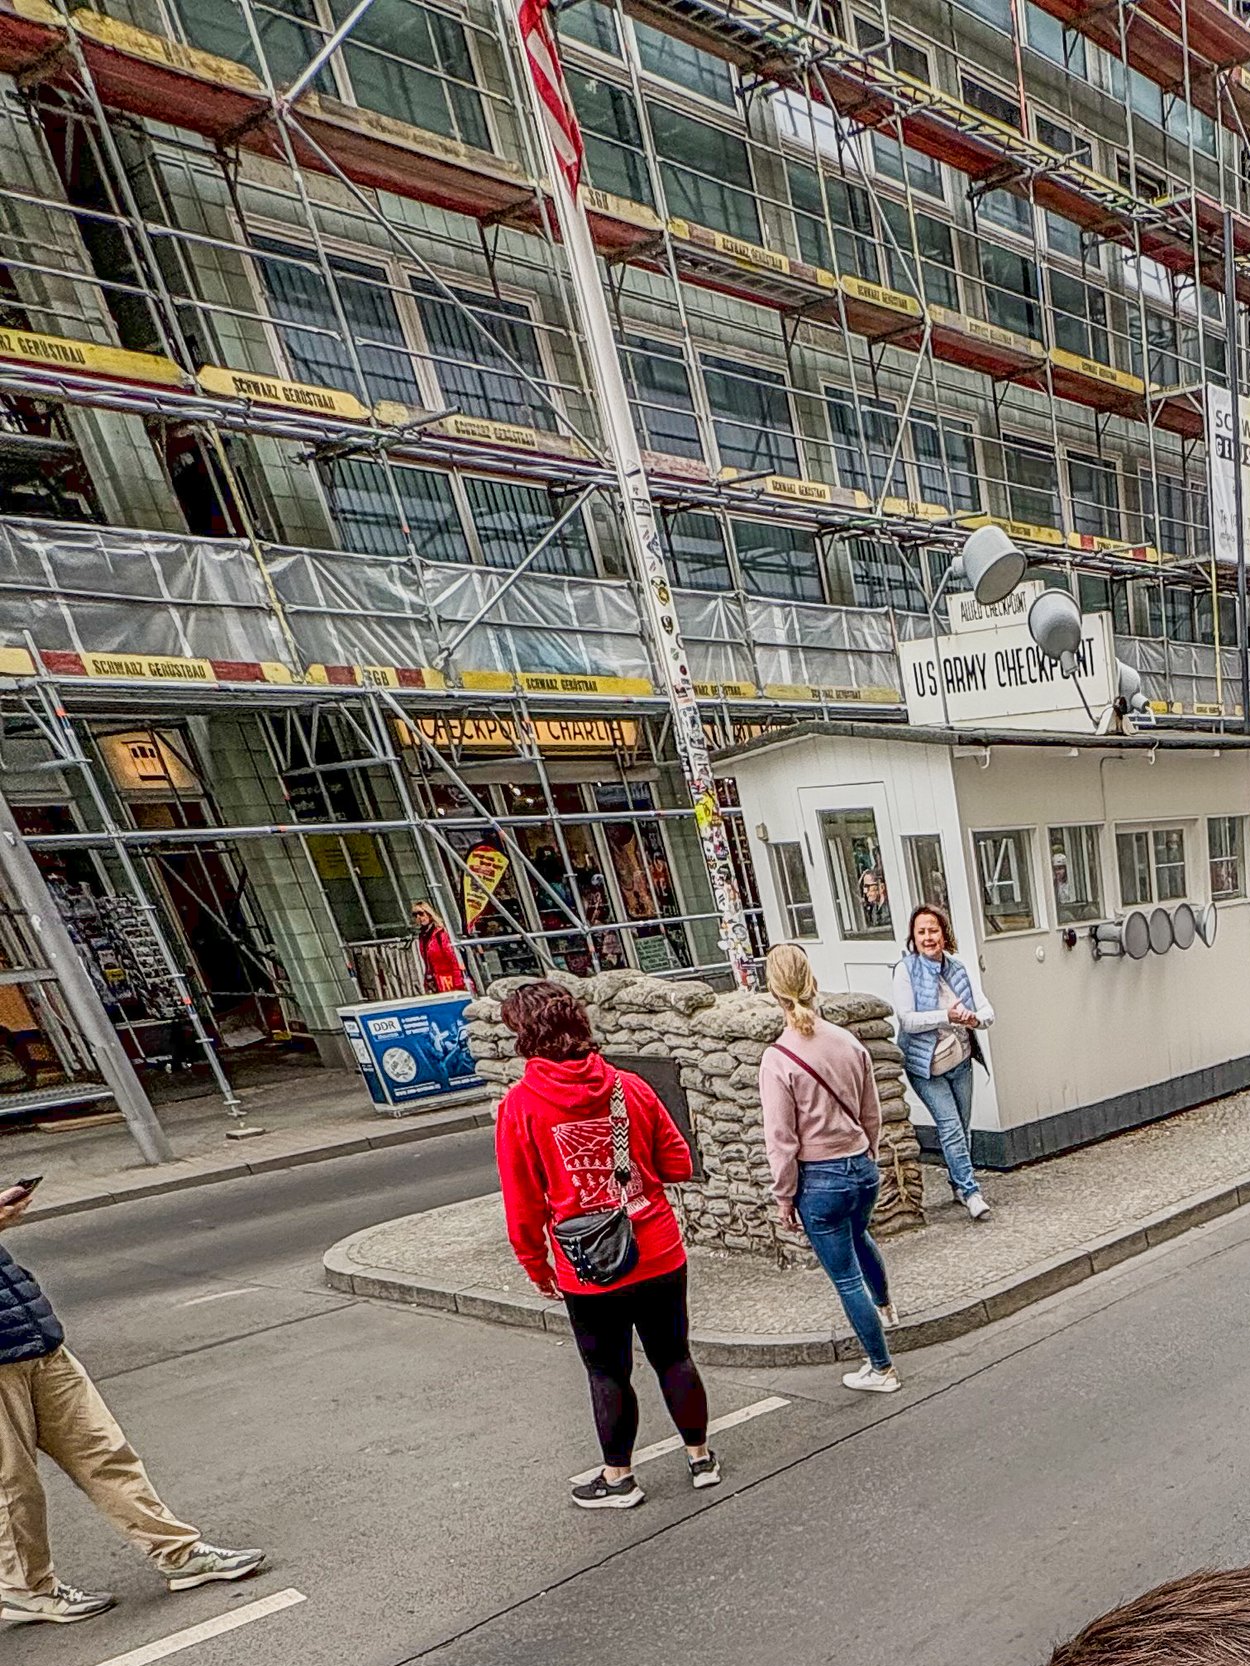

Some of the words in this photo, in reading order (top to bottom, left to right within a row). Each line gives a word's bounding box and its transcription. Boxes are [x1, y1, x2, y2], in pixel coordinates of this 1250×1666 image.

[232, 376, 281, 401] SCHWARZ
[92, 659, 146, 677] SCHWARZ
[149, 661, 207, 680] GERÜSTBAU
[913, 660, 938, 698] US
[943, 653, 987, 694] ARMY
[995, 637, 1095, 688] CHECKPNT
[373, 1020, 396, 1032] DDR
